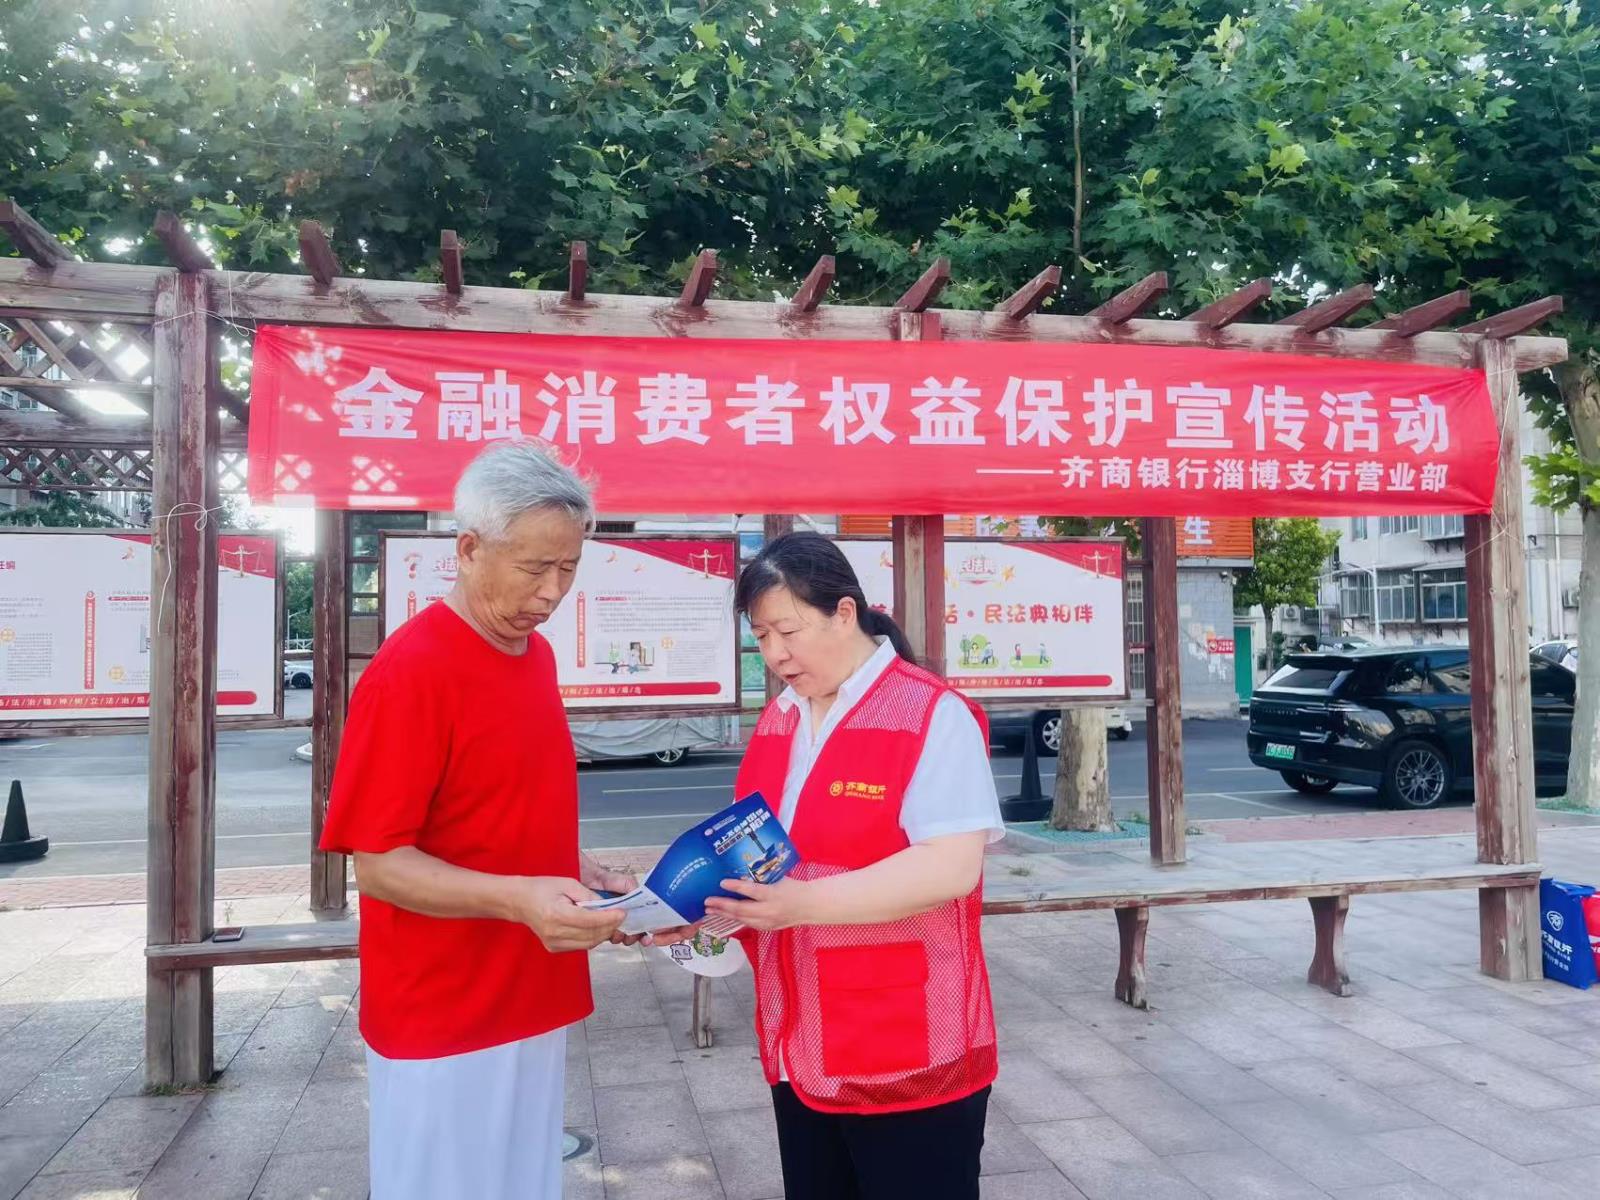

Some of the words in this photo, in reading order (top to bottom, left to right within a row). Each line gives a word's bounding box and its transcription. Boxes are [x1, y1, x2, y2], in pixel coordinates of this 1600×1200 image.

[334, 366, 1450, 453] 金融消费者权益保护宣传活动
[1183, 515, 1213, 545] 生
